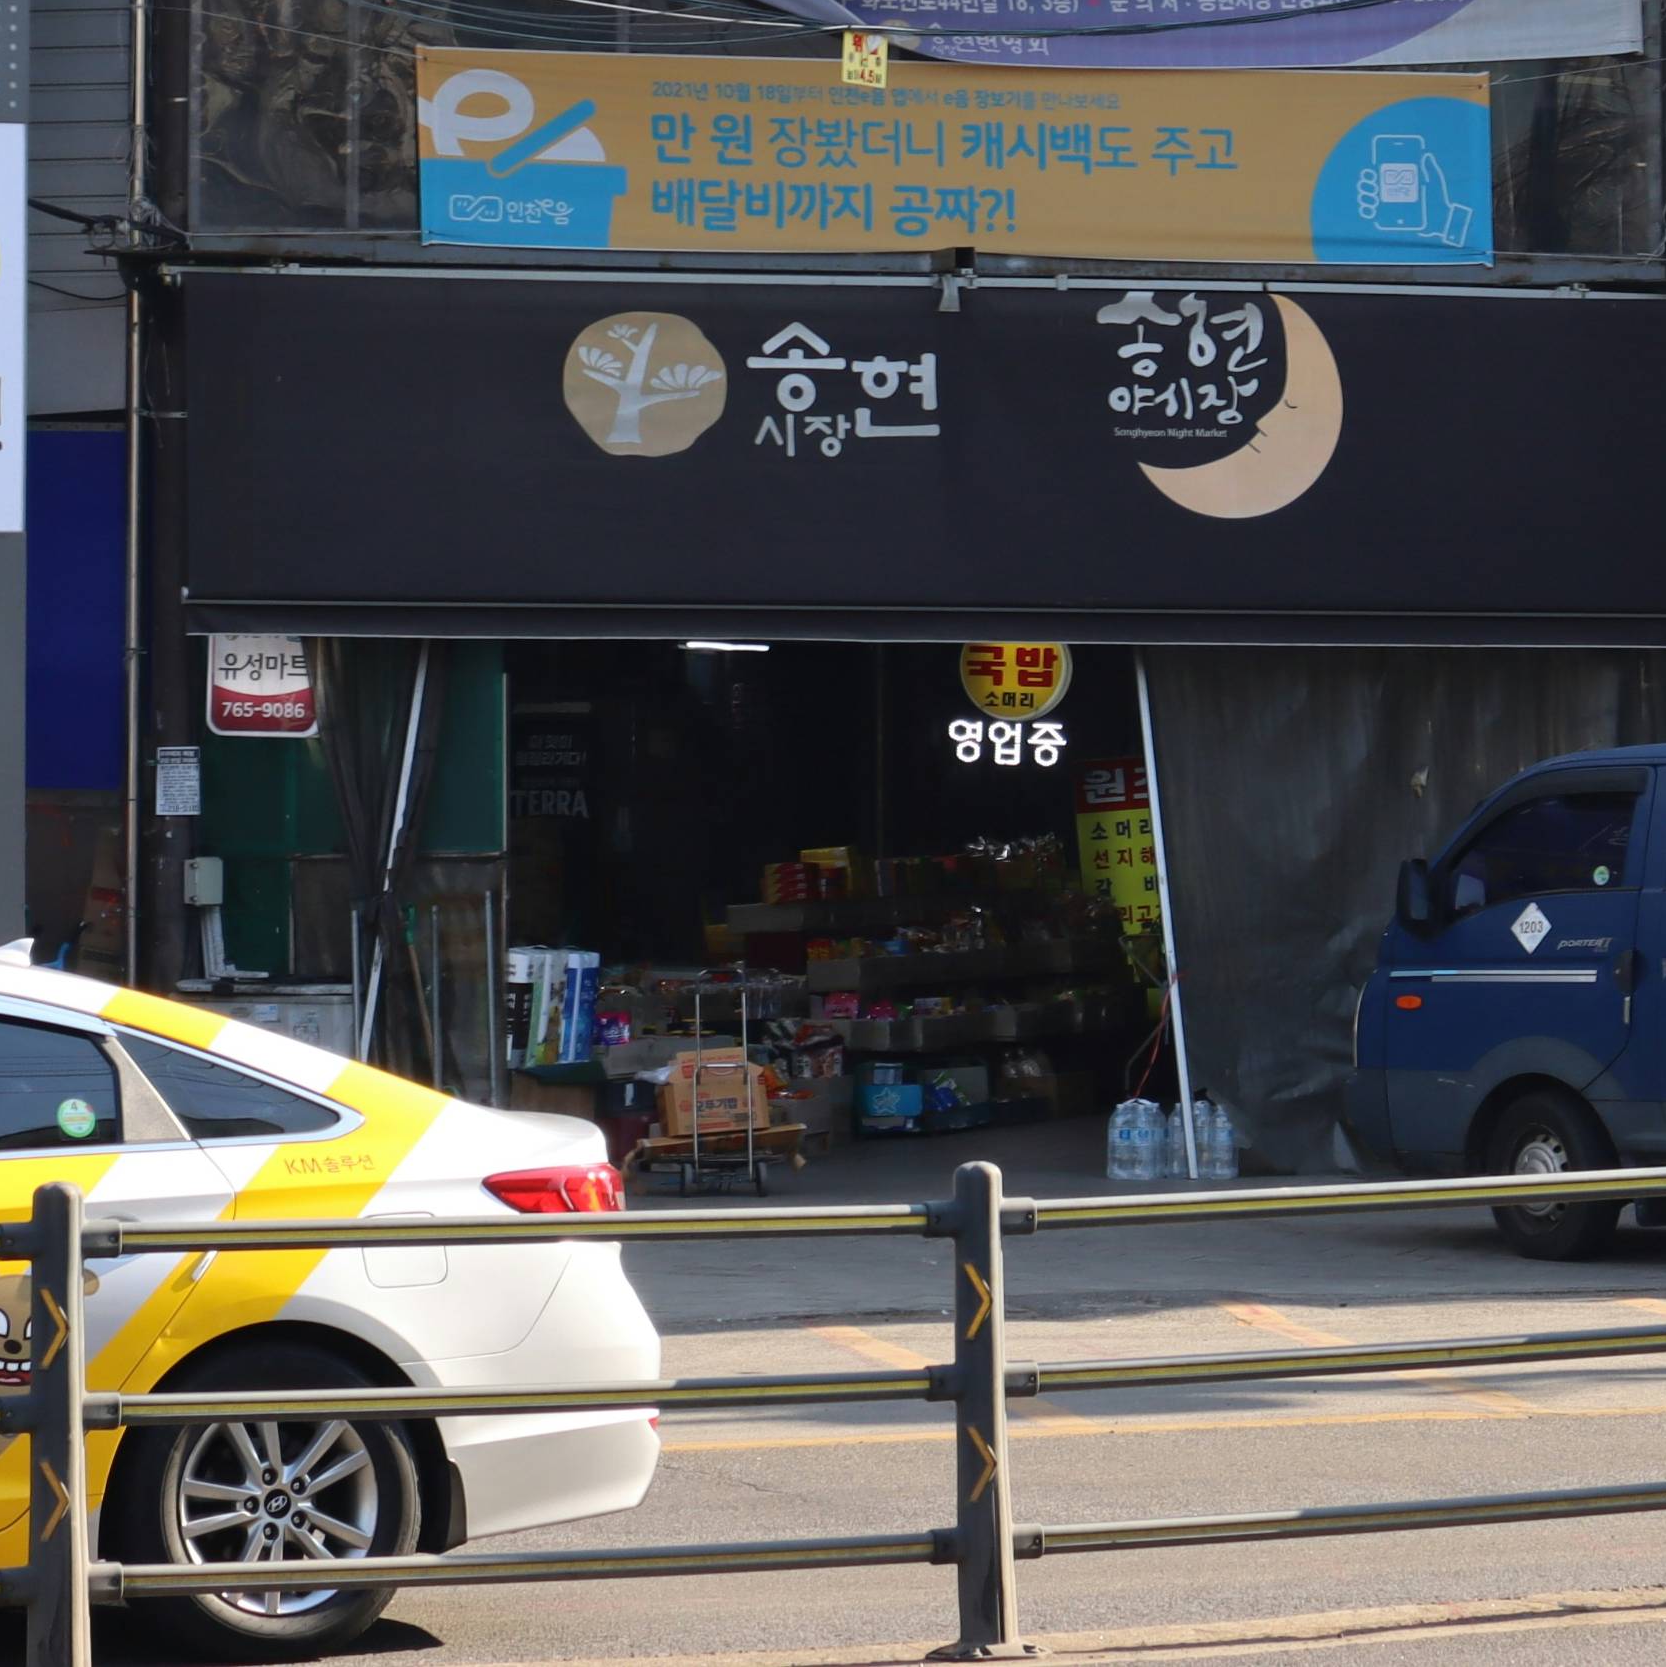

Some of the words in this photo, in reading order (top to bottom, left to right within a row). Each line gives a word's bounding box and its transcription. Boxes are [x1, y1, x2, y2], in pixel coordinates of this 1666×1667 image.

[652, 80, 709, 102] 2021년
[651, 113, 693, 166] 만
[711, 113, 754, 166] 원
[769, 117, 945, 170] 장봤더니
[961, 120, 1140, 173] 캐시백도
[1151, 125, 1239, 176] 주고
[651, 179, 874, 233] 배달비까지
[889, 184, 1017, 237] 공짜?!
[746, 320, 941, 441] 송현
[1107, 375, 1260, 426] 야시장
[752, 411, 852, 459] 시장
[217, 652, 310, 682] 유성마트
[965, 645, 1059, 688] 국밥
[221, 701, 305, 720] 765-9086
[983, 691, 1035, 708] 소머리
[947, 719, 1068, 767] 영업중
[1519, 920, 1544, 935] 1203
